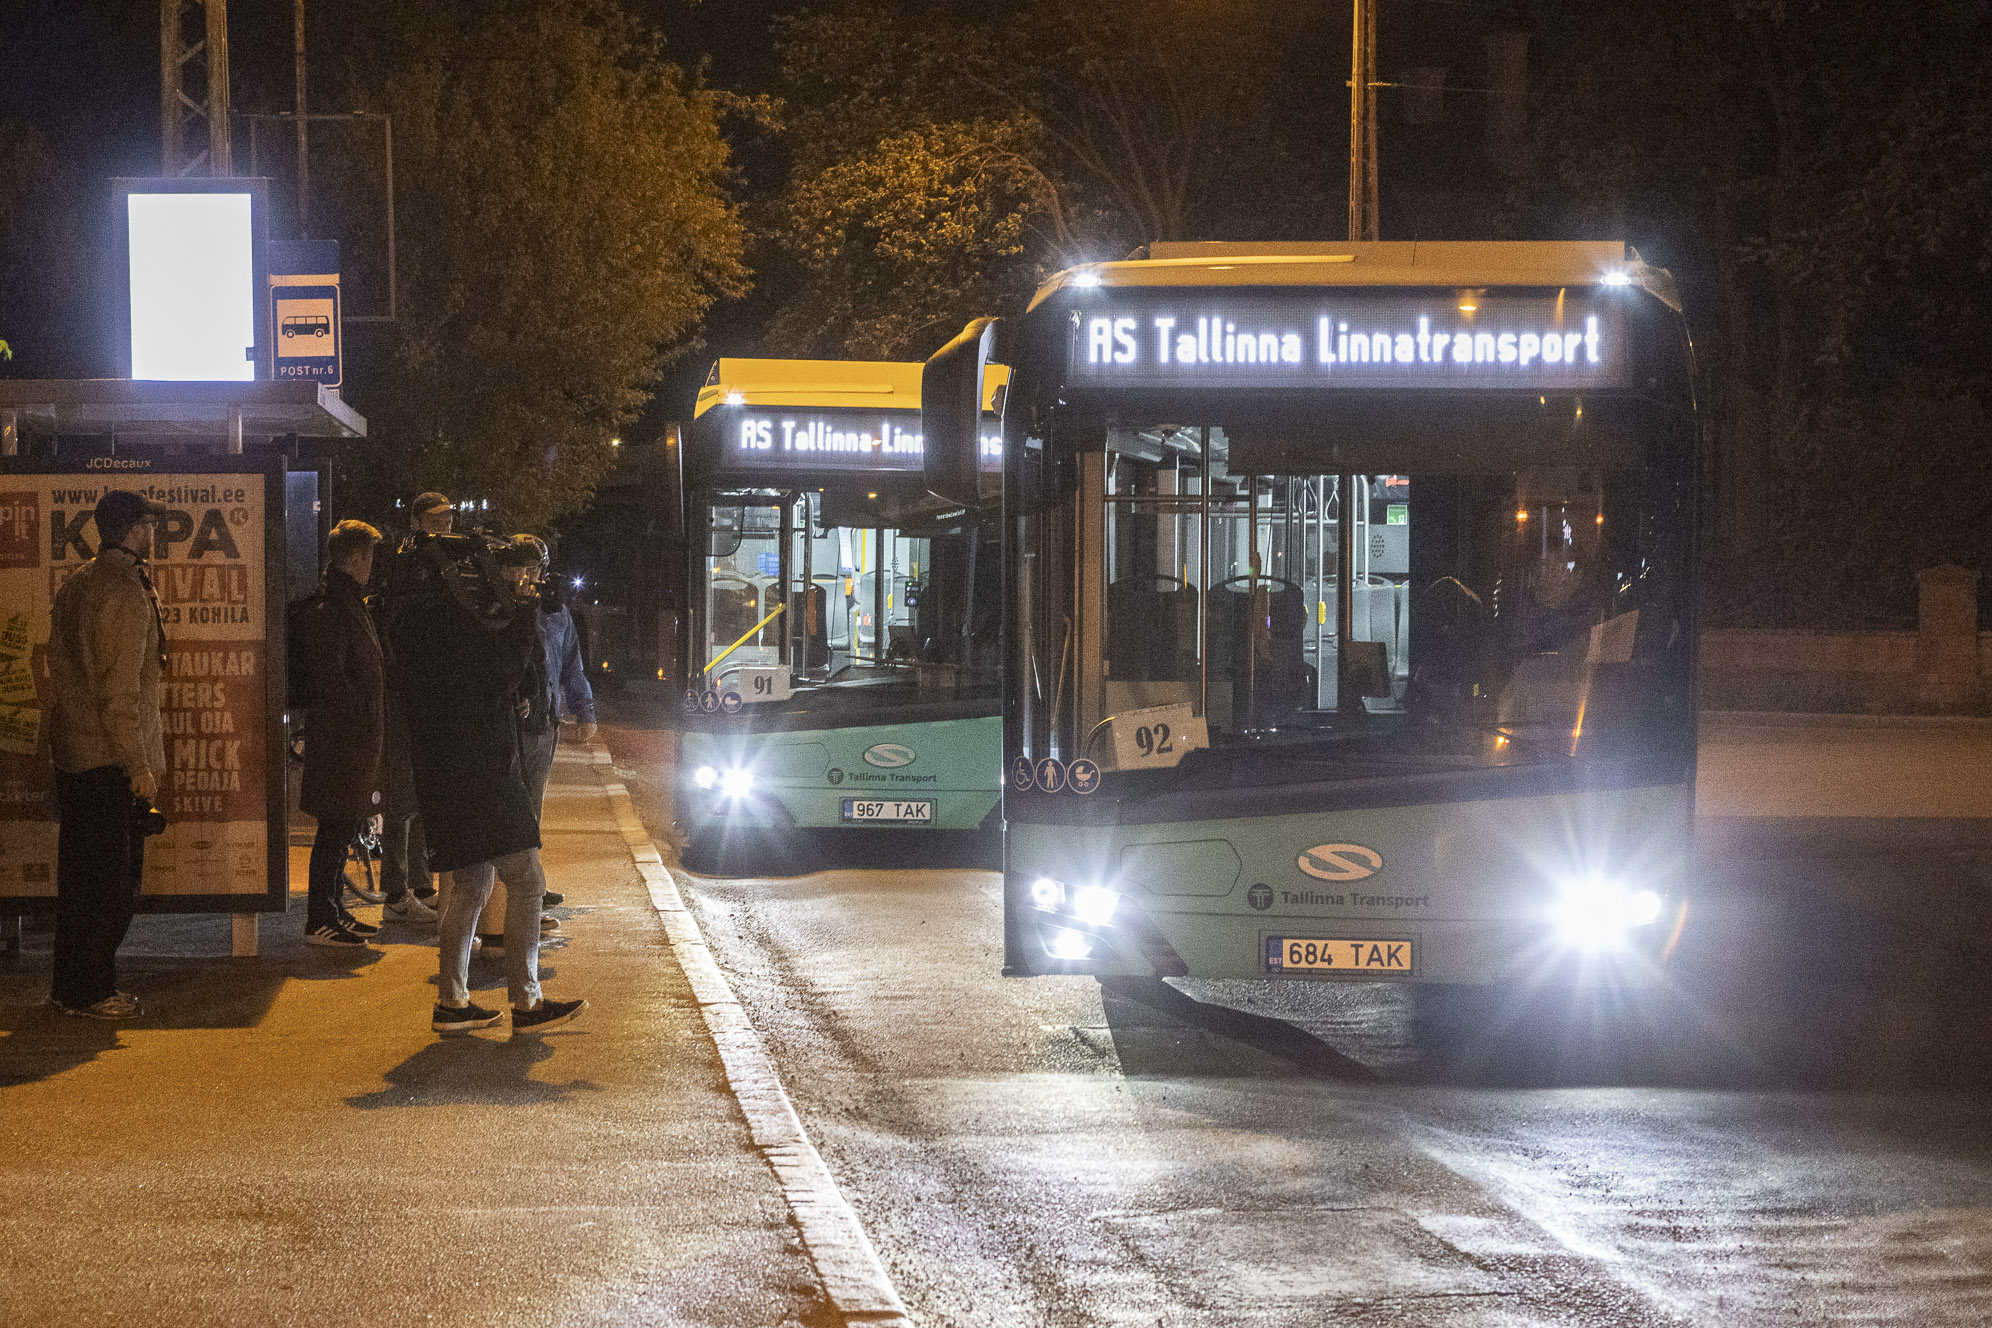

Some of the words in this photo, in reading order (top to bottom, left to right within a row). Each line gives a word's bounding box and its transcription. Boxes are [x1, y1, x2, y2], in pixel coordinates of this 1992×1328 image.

[1089, 317, 1136, 364] AS
[1156, 317, 1302, 364] Tallinna
[1319, 316, 1600, 366] Linnatransport
[281, 365, 311, 375] POST
[741, 420, 772, 449] AS
[782, 421, 872, 453] Tallinna
[86, 457, 151, 469] JCDecaux
[51, 508, 241, 560] KPA
[189, 607, 250, 624] KOHILA
[159, 682, 226, 709] TTERS
[753, 676, 773, 695] 91
[160, 711, 196, 734] AUL
[200, 711, 235, 734] OJA
[1135, 723, 1173, 758] 92
[173, 738, 242, 770] MICK
[173, 770, 241, 792] PEDAJA
[848, 772, 887, 782] Tallinna
[890, 773, 937, 784] Transport
[857, 803, 884, 818] 967
[894, 803, 927, 818] TAK
[1281, 891, 1345, 906] Tallinna
[1350, 893, 1429, 908] Transport
[1269, 957, 1282, 965] EST
[1289, 943, 1333, 966] 684
[1350, 943, 1404, 967] TAK
